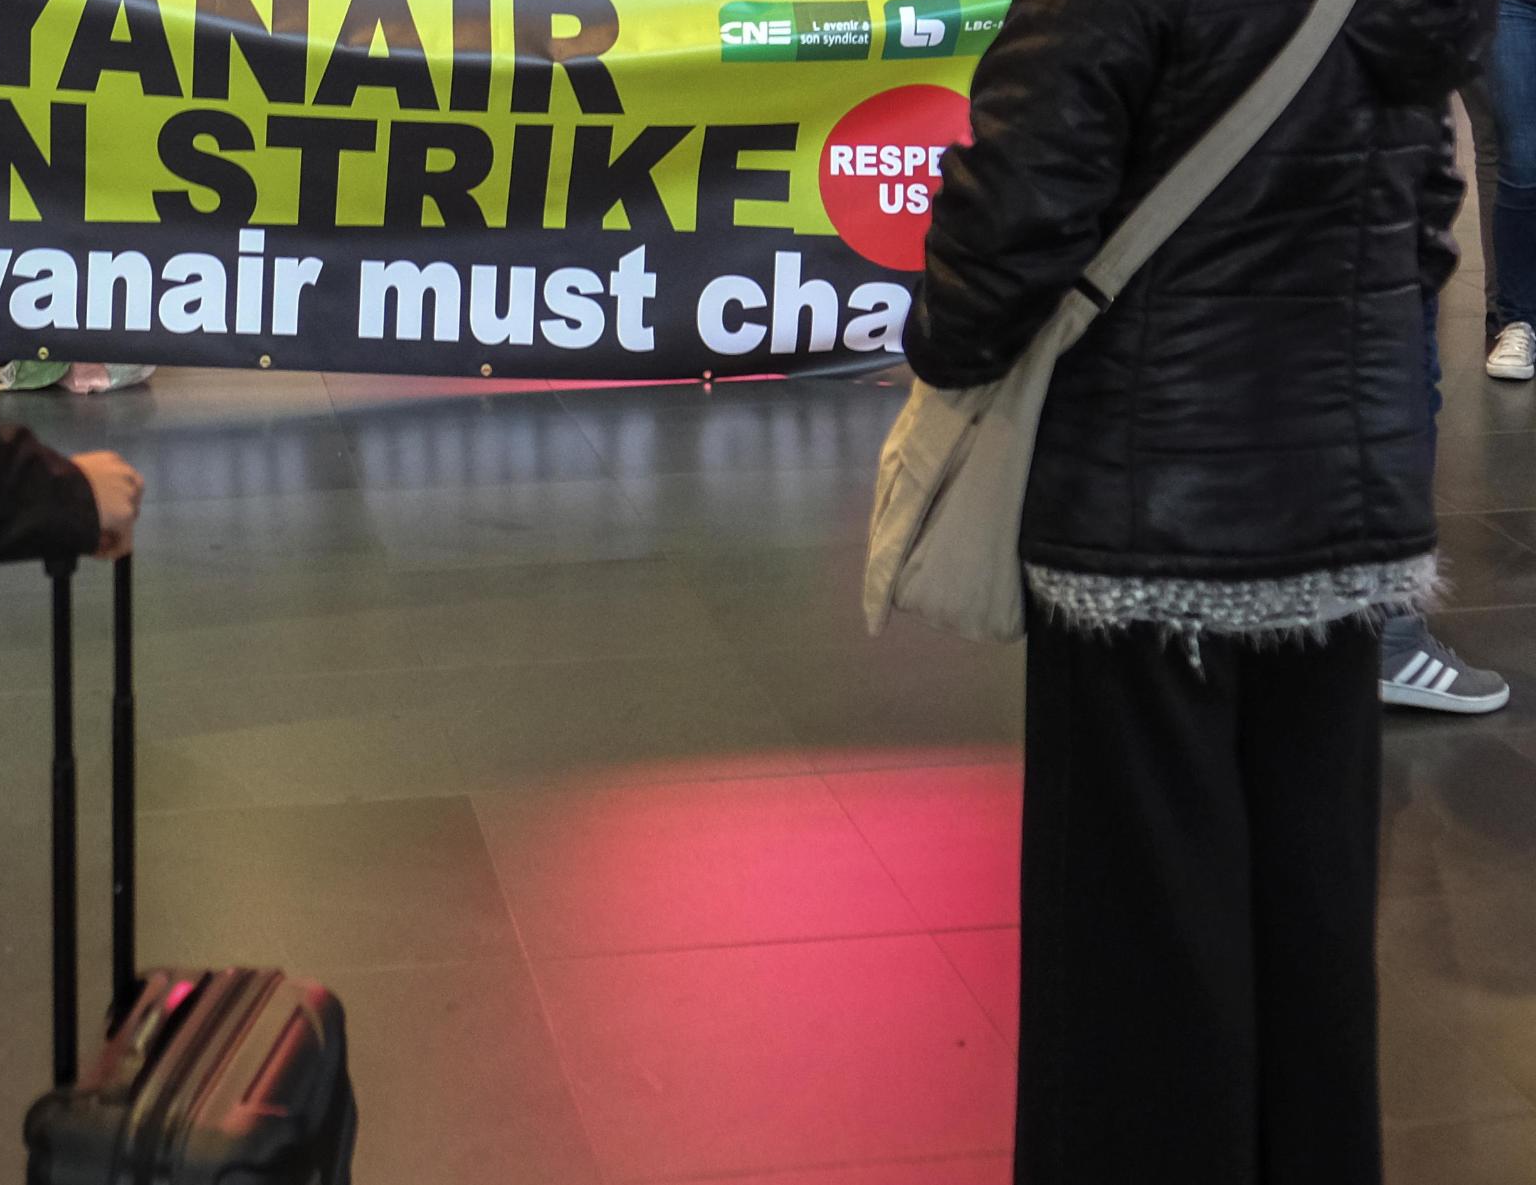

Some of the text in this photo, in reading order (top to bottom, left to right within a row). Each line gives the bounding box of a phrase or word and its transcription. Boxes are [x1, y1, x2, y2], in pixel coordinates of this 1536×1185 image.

[720, 20, 792, 46] CNE
[800, 32, 869, 47] son syndicat
[152, 108, 800, 233] STRIKE
[830, 145, 946, 177] RESPE
[879, 183, 929, 215] US
[358, 244, 657, 353] must
[697, 251, 913, 355] cha
